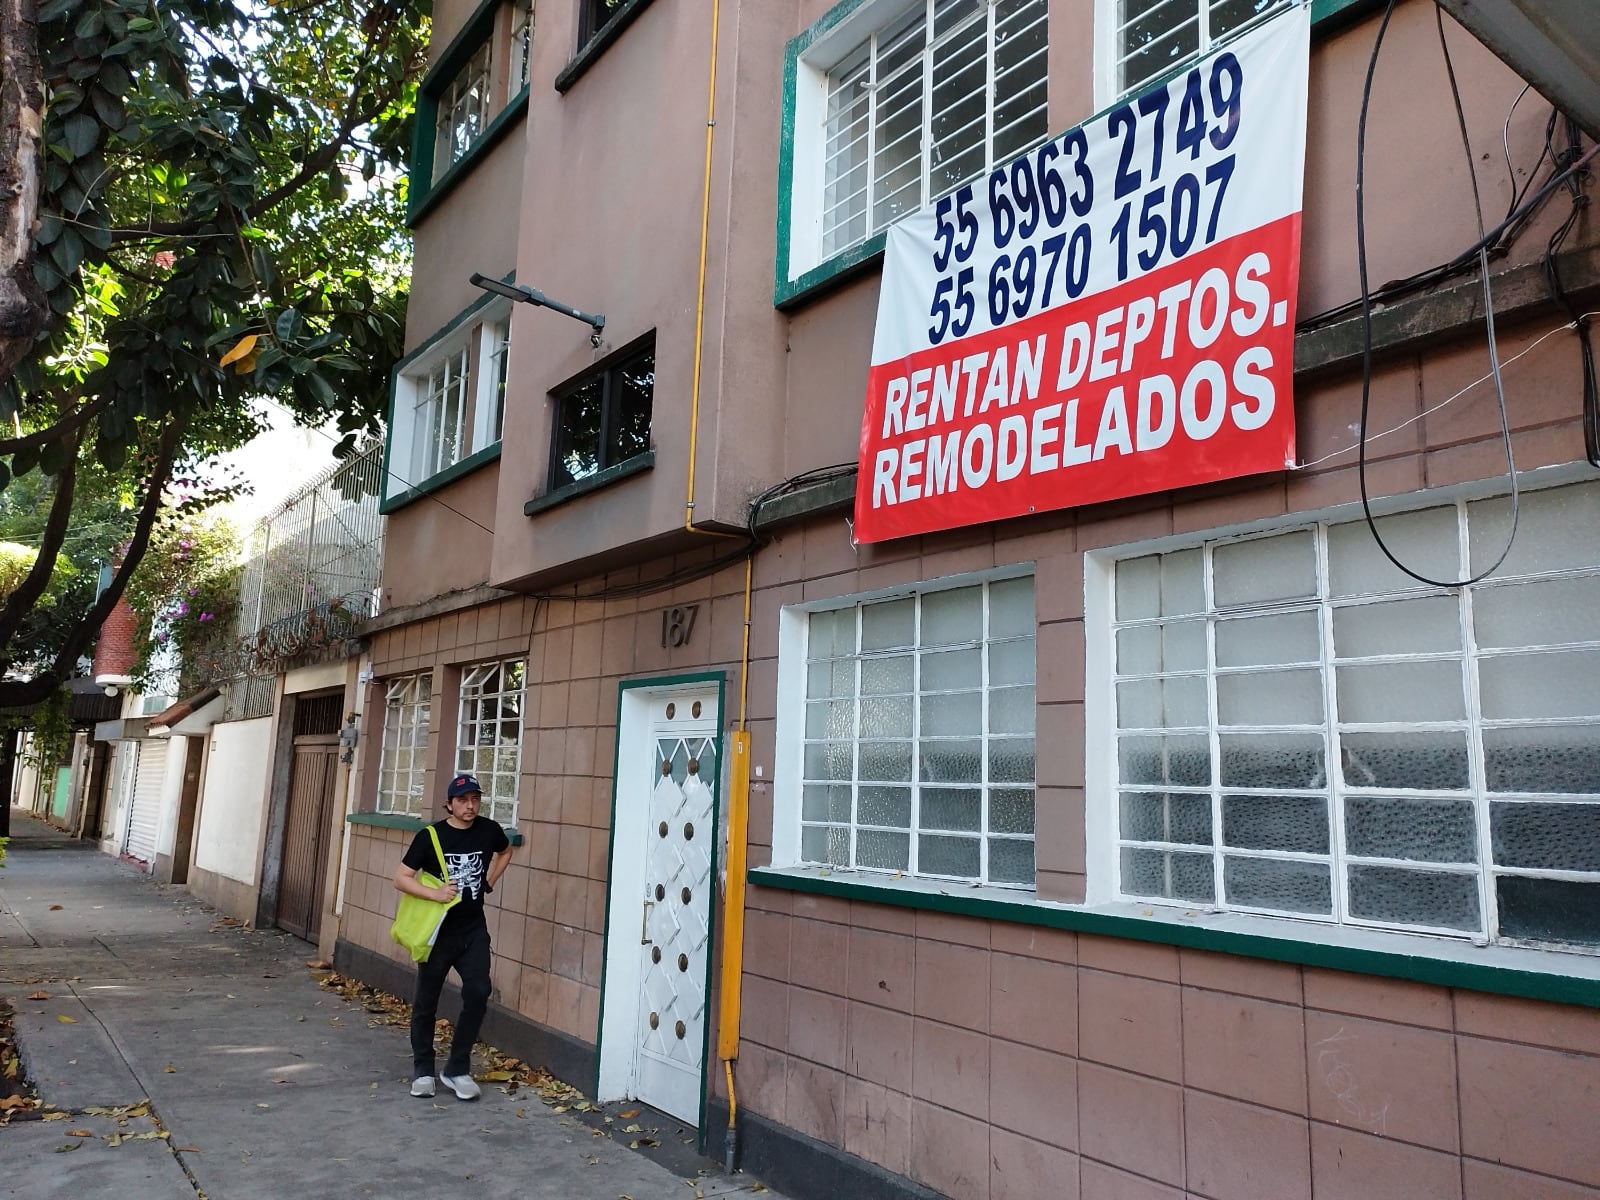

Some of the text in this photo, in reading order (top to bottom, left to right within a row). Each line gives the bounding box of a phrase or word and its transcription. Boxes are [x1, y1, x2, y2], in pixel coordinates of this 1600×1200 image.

[928, 153, 1236, 345] 55 6970 1507
[933, 52, 1243, 273] 55 6963 2749
[873, 346, 1276, 509] REMODELADOS
[882, 252, 1288, 440] RENTAN DEPTOS.
[661, 604, 700, 649] 187
